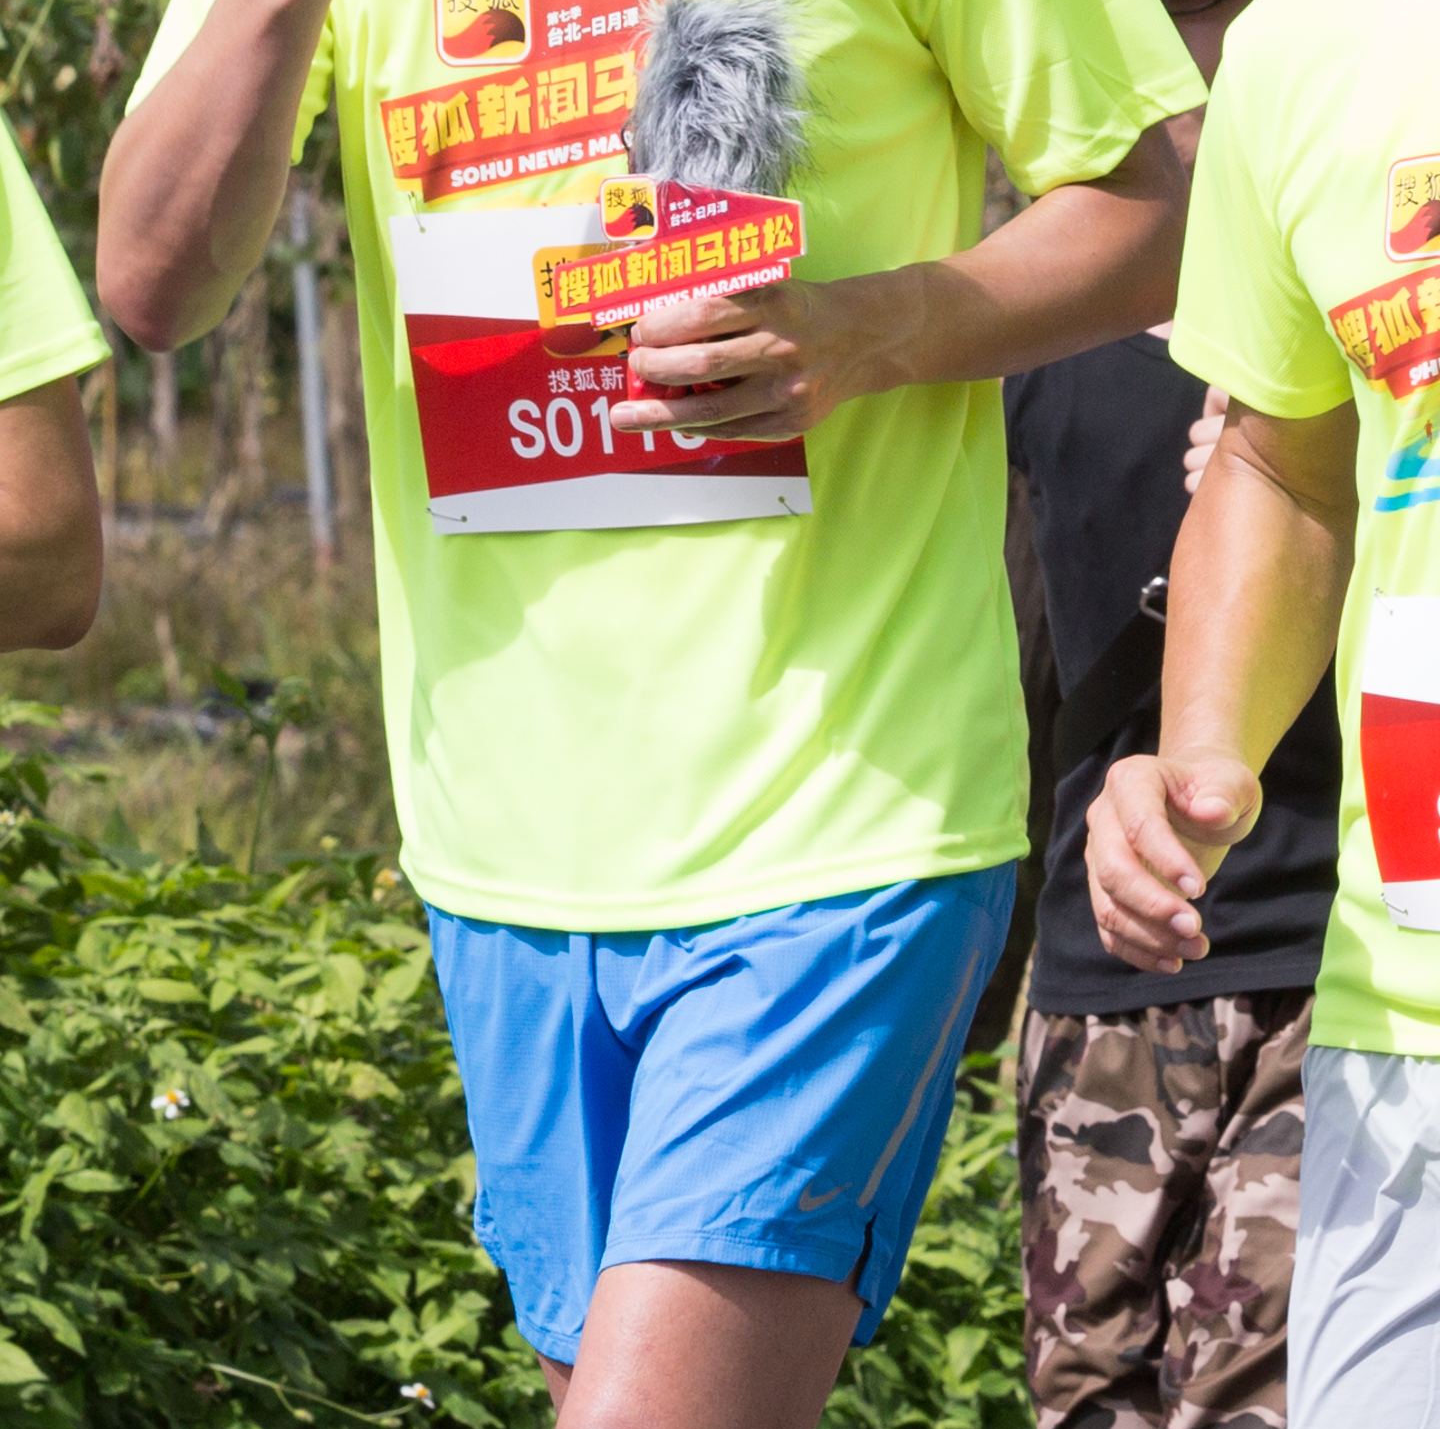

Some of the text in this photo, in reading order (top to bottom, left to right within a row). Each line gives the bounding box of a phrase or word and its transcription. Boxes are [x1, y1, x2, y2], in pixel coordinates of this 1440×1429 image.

[547, 5, 582, 26] 第七季
[388, 49, 648, 167] 搜狐新闻马
[450, 158, 513, 188] SOHU
[518, 142, 584, 174] NEWS
[606, 186, 651, 208] 搜狐
[558, 213, 794, 309] 搜狐新闻马拉松
[596, 266, 784, 326] SOHU NEWS MARATHON
[508, 396, 708, 459] S01
